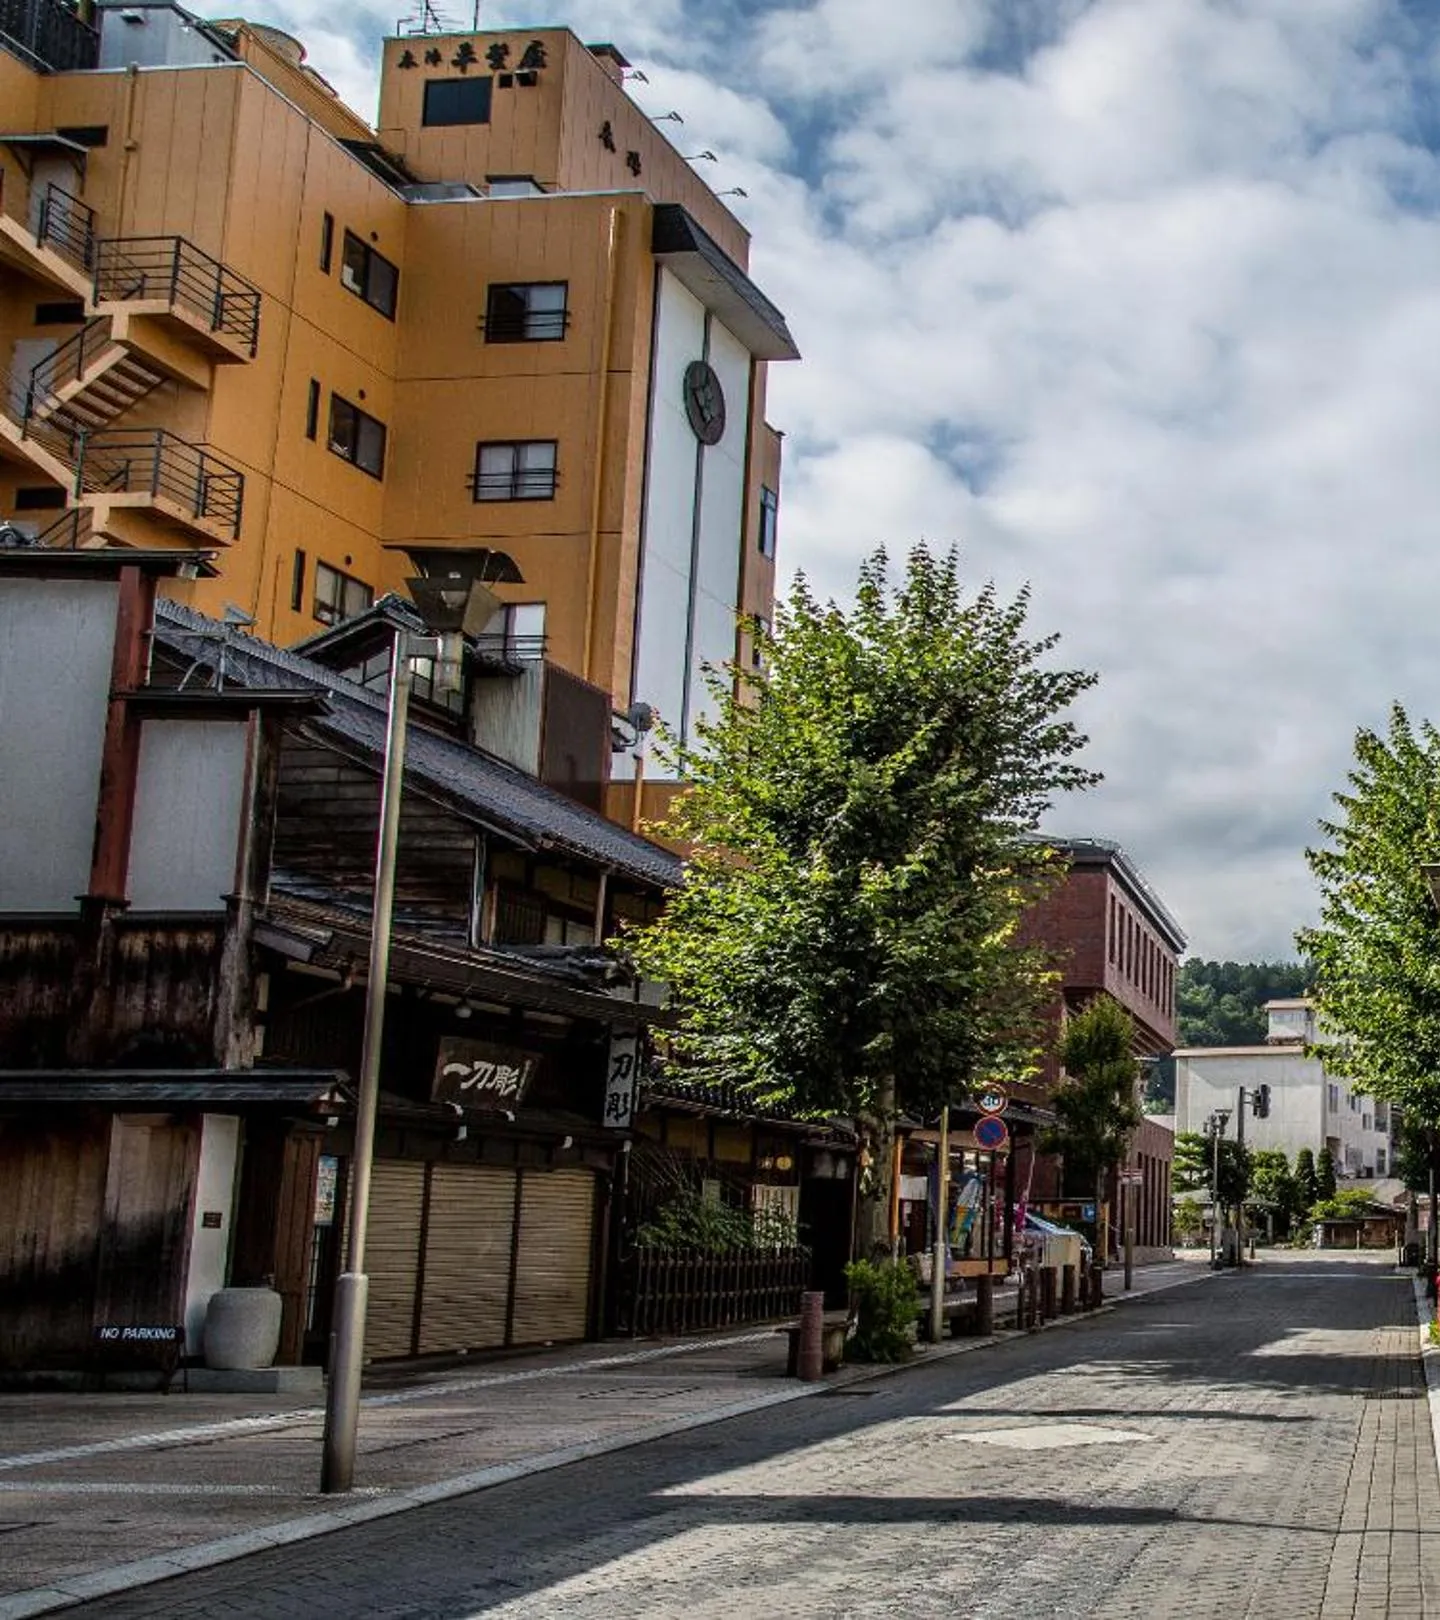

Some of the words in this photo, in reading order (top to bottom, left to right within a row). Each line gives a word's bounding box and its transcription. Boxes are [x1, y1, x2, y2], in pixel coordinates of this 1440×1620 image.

[442, 1061, 520, 1096] 一刀彫
[100, 1327, 120, 1339] NO
[122, 1327, 176, 1339] PARKING
